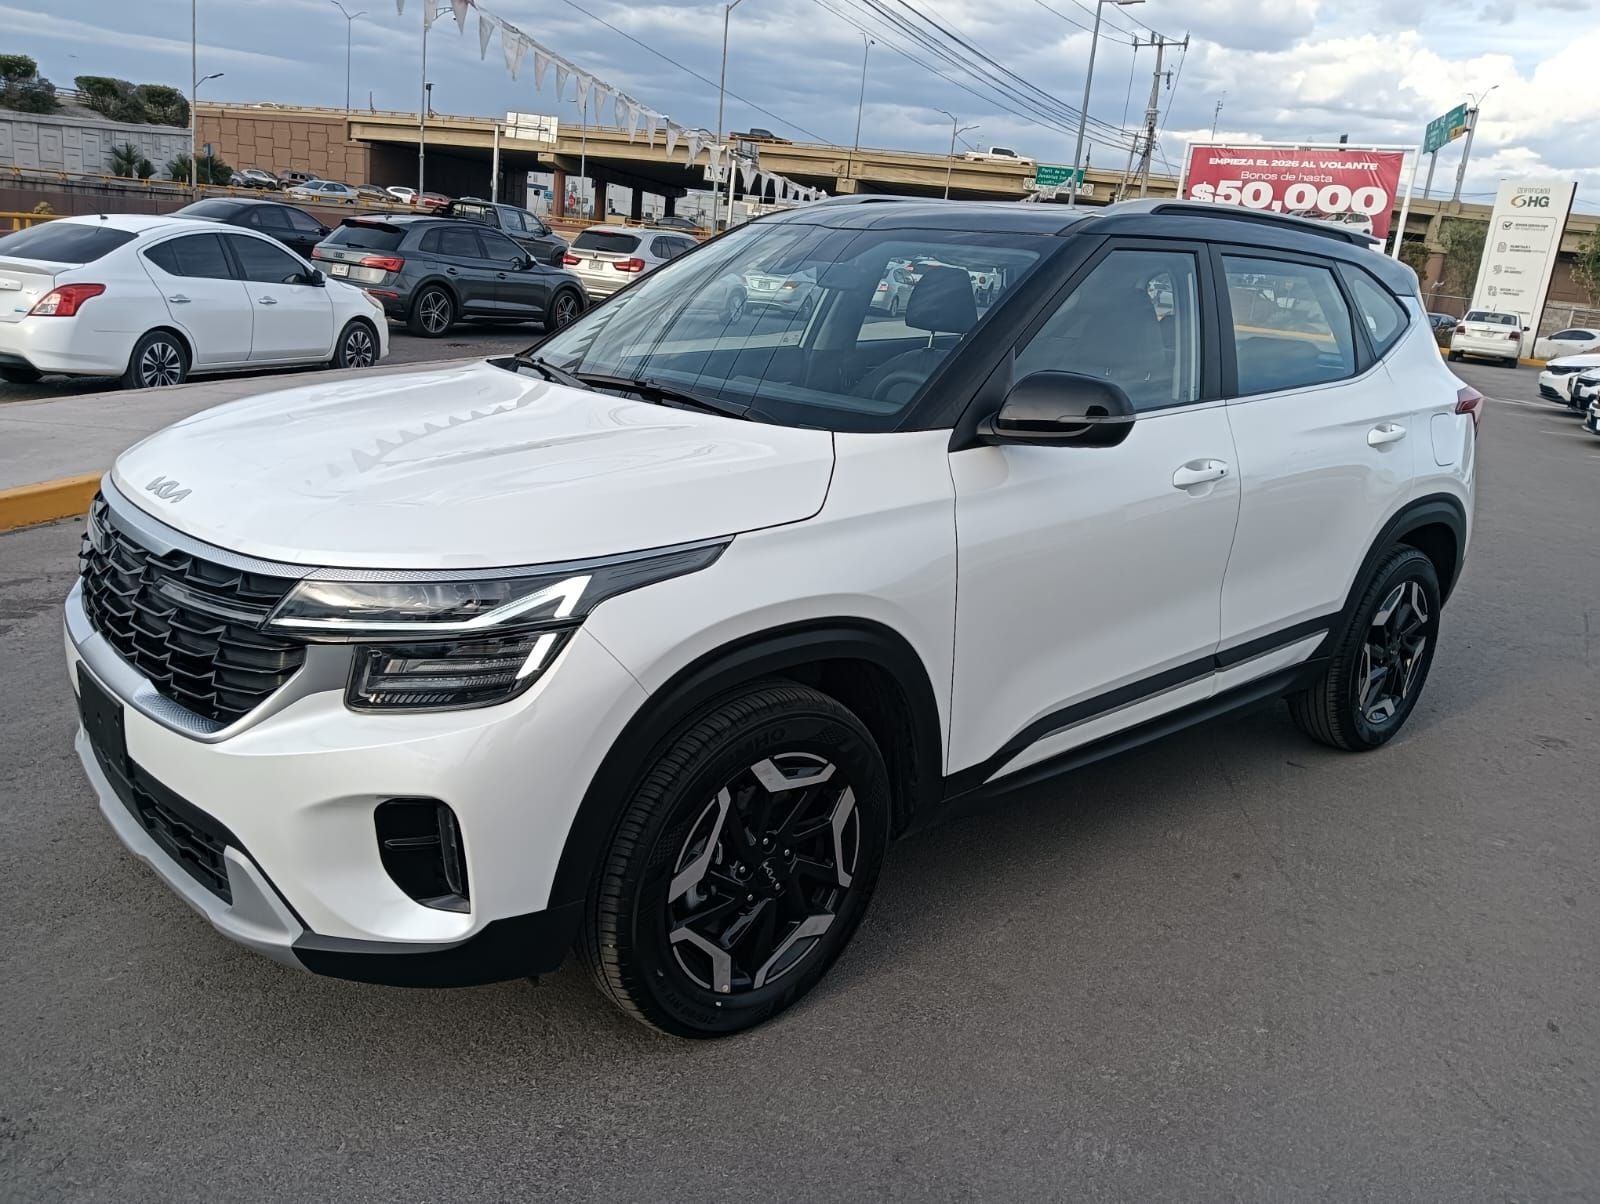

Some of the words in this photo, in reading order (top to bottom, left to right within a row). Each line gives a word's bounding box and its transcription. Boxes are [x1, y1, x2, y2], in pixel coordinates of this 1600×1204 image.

[1209, 157, 1254, 166] EMPIEZA
[1256, 159, 1269, 167] EL
[1271, 160, 1300, 168] 2026
[1301, 160, 1317, 168] AL
[1320, 161, 1379, 171] VOLANTE
[1241, 171, 1278, 180] Bonos
[1280, 172, 1296, 181] de
[1299, 172, 1333, 183] hasta
[1189, 179, 1388, 217] $50,000
[1527, 195, 1550, 208] HG
[145, 475, 192, 504] KIA
